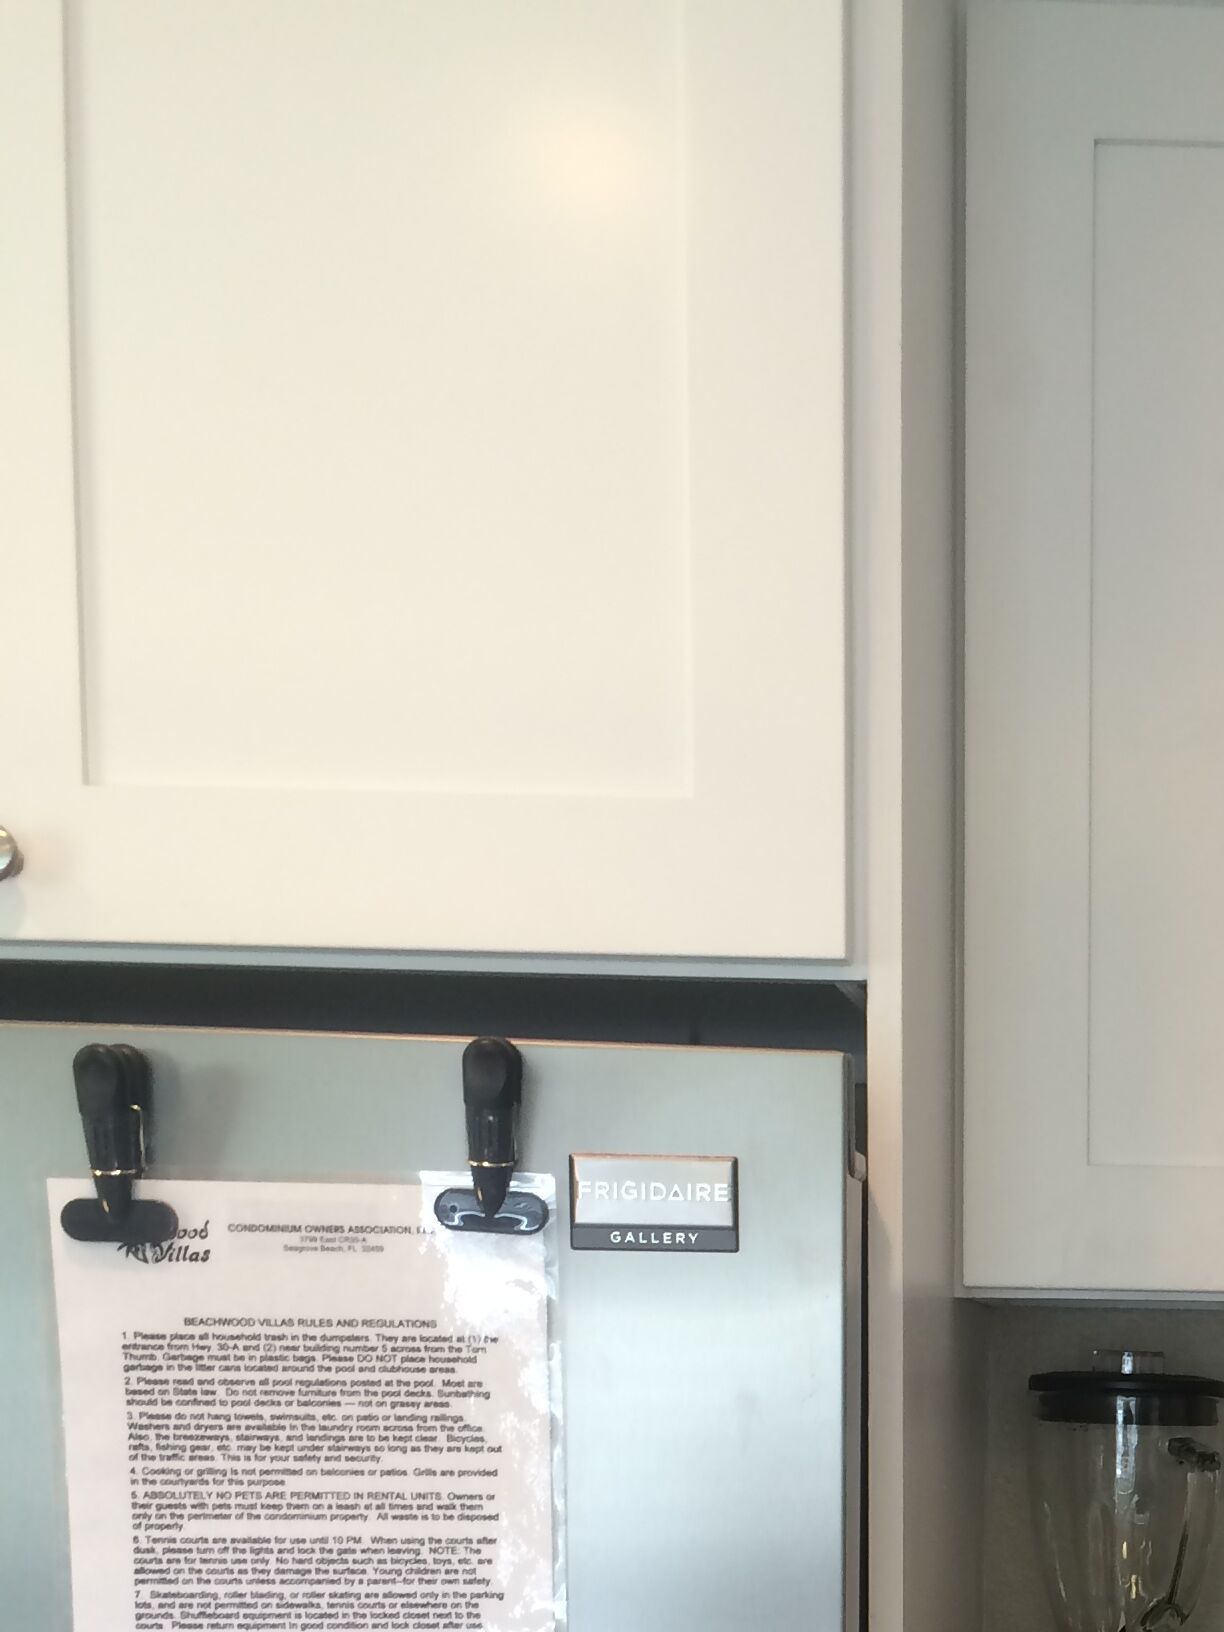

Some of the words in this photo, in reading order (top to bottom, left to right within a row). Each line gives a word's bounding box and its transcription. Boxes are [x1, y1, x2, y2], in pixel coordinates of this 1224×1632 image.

[579, 1181, 729, 1202] FRIGIDAIRE
[228, 1224, 302, 1233] CONDOMINIUM
[305, 1225, 345, 1234] OWNERS
[610, 1231, 699, 1244] GALLERY
[153, 1242, 211, 1264] Villas
[184, 1318, 256, 1328] BEACHWOOD
[258, 1318, 295, 1328] VILLAS
[297, 1319, 333, 1328] RULES
[336, 1319, 359, 1329] AND
[361, 1319, 437, 1329] REGULATIONS
